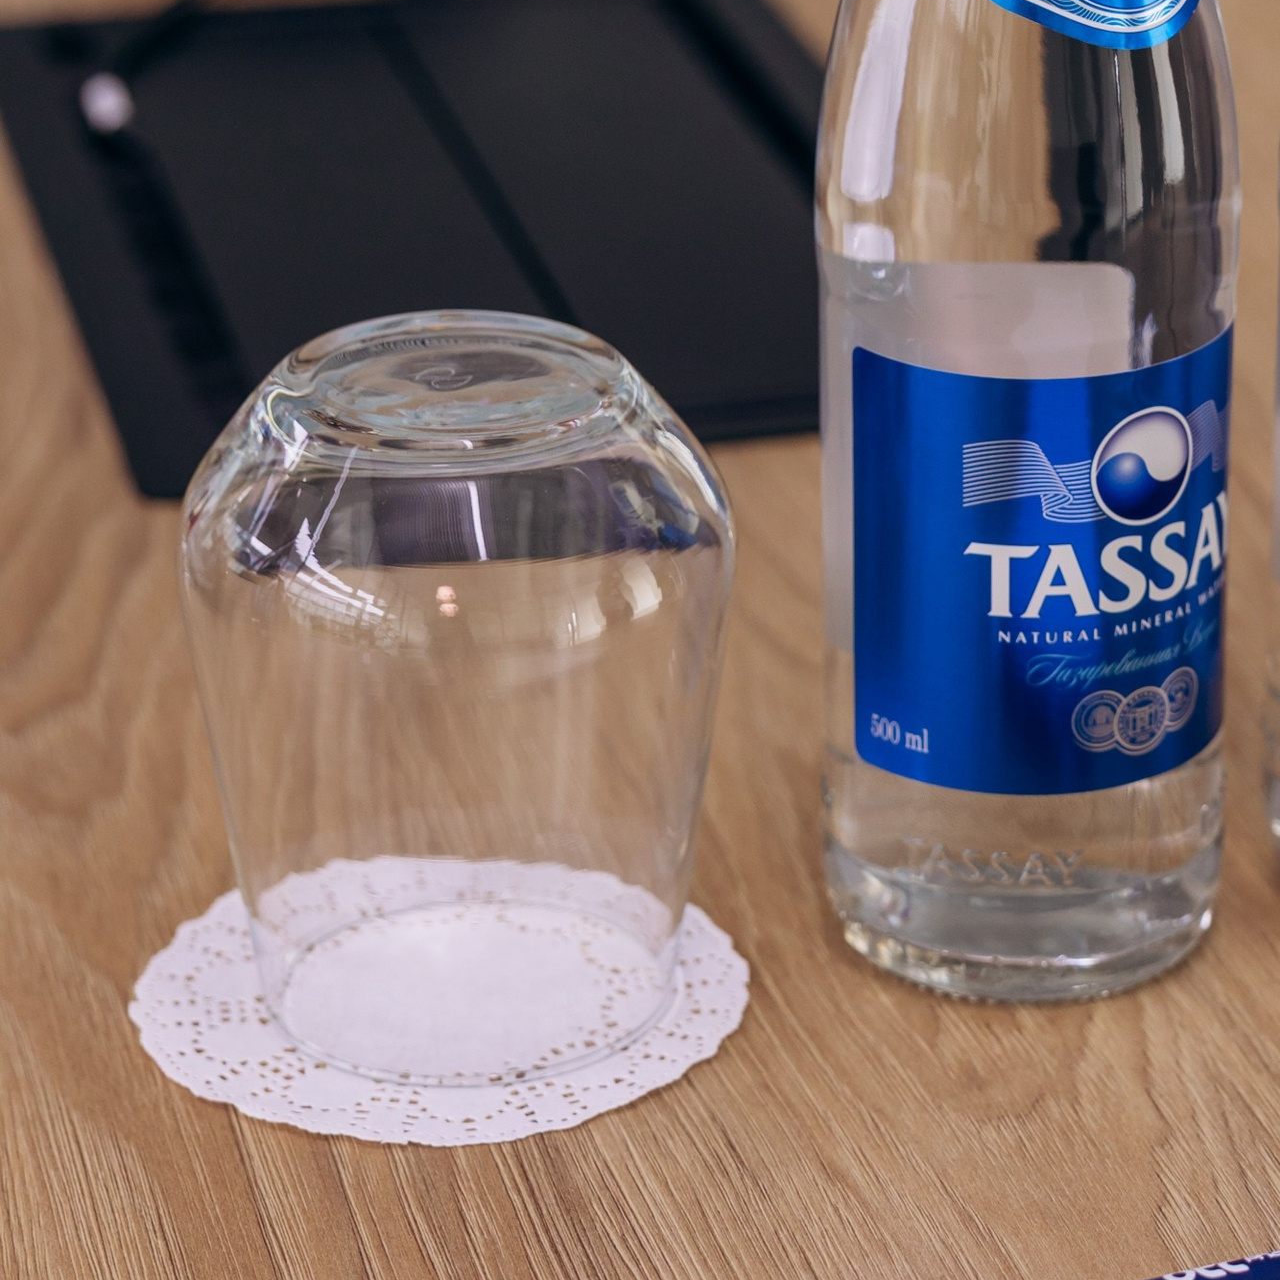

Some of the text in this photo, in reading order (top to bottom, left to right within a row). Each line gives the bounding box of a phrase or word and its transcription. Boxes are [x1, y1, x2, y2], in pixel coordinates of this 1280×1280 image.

[997, 628, 1101, 645] NATURAL
[1113, 601, 1191, 637] MINERAL
[870, 713, 929, 754] 500 ml
